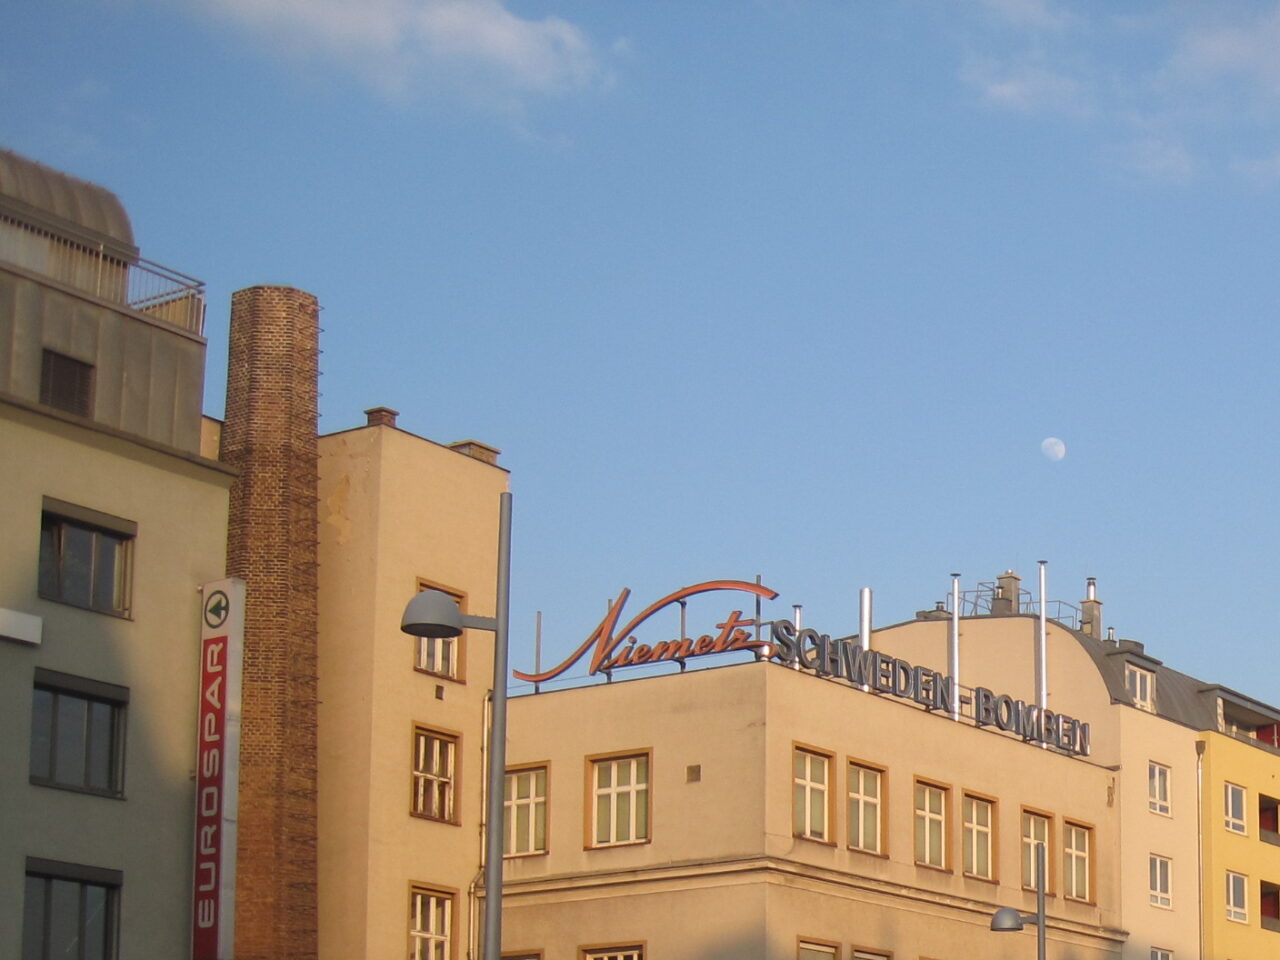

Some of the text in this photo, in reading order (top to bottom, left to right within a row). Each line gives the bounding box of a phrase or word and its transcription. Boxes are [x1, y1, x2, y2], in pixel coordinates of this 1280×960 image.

[512, 579, 780, 682] Niemetz
[771, 619, 1091, 756] SCHWEDEN-BOMBEN
[198, 642, 224, 928] EUROSPAR
